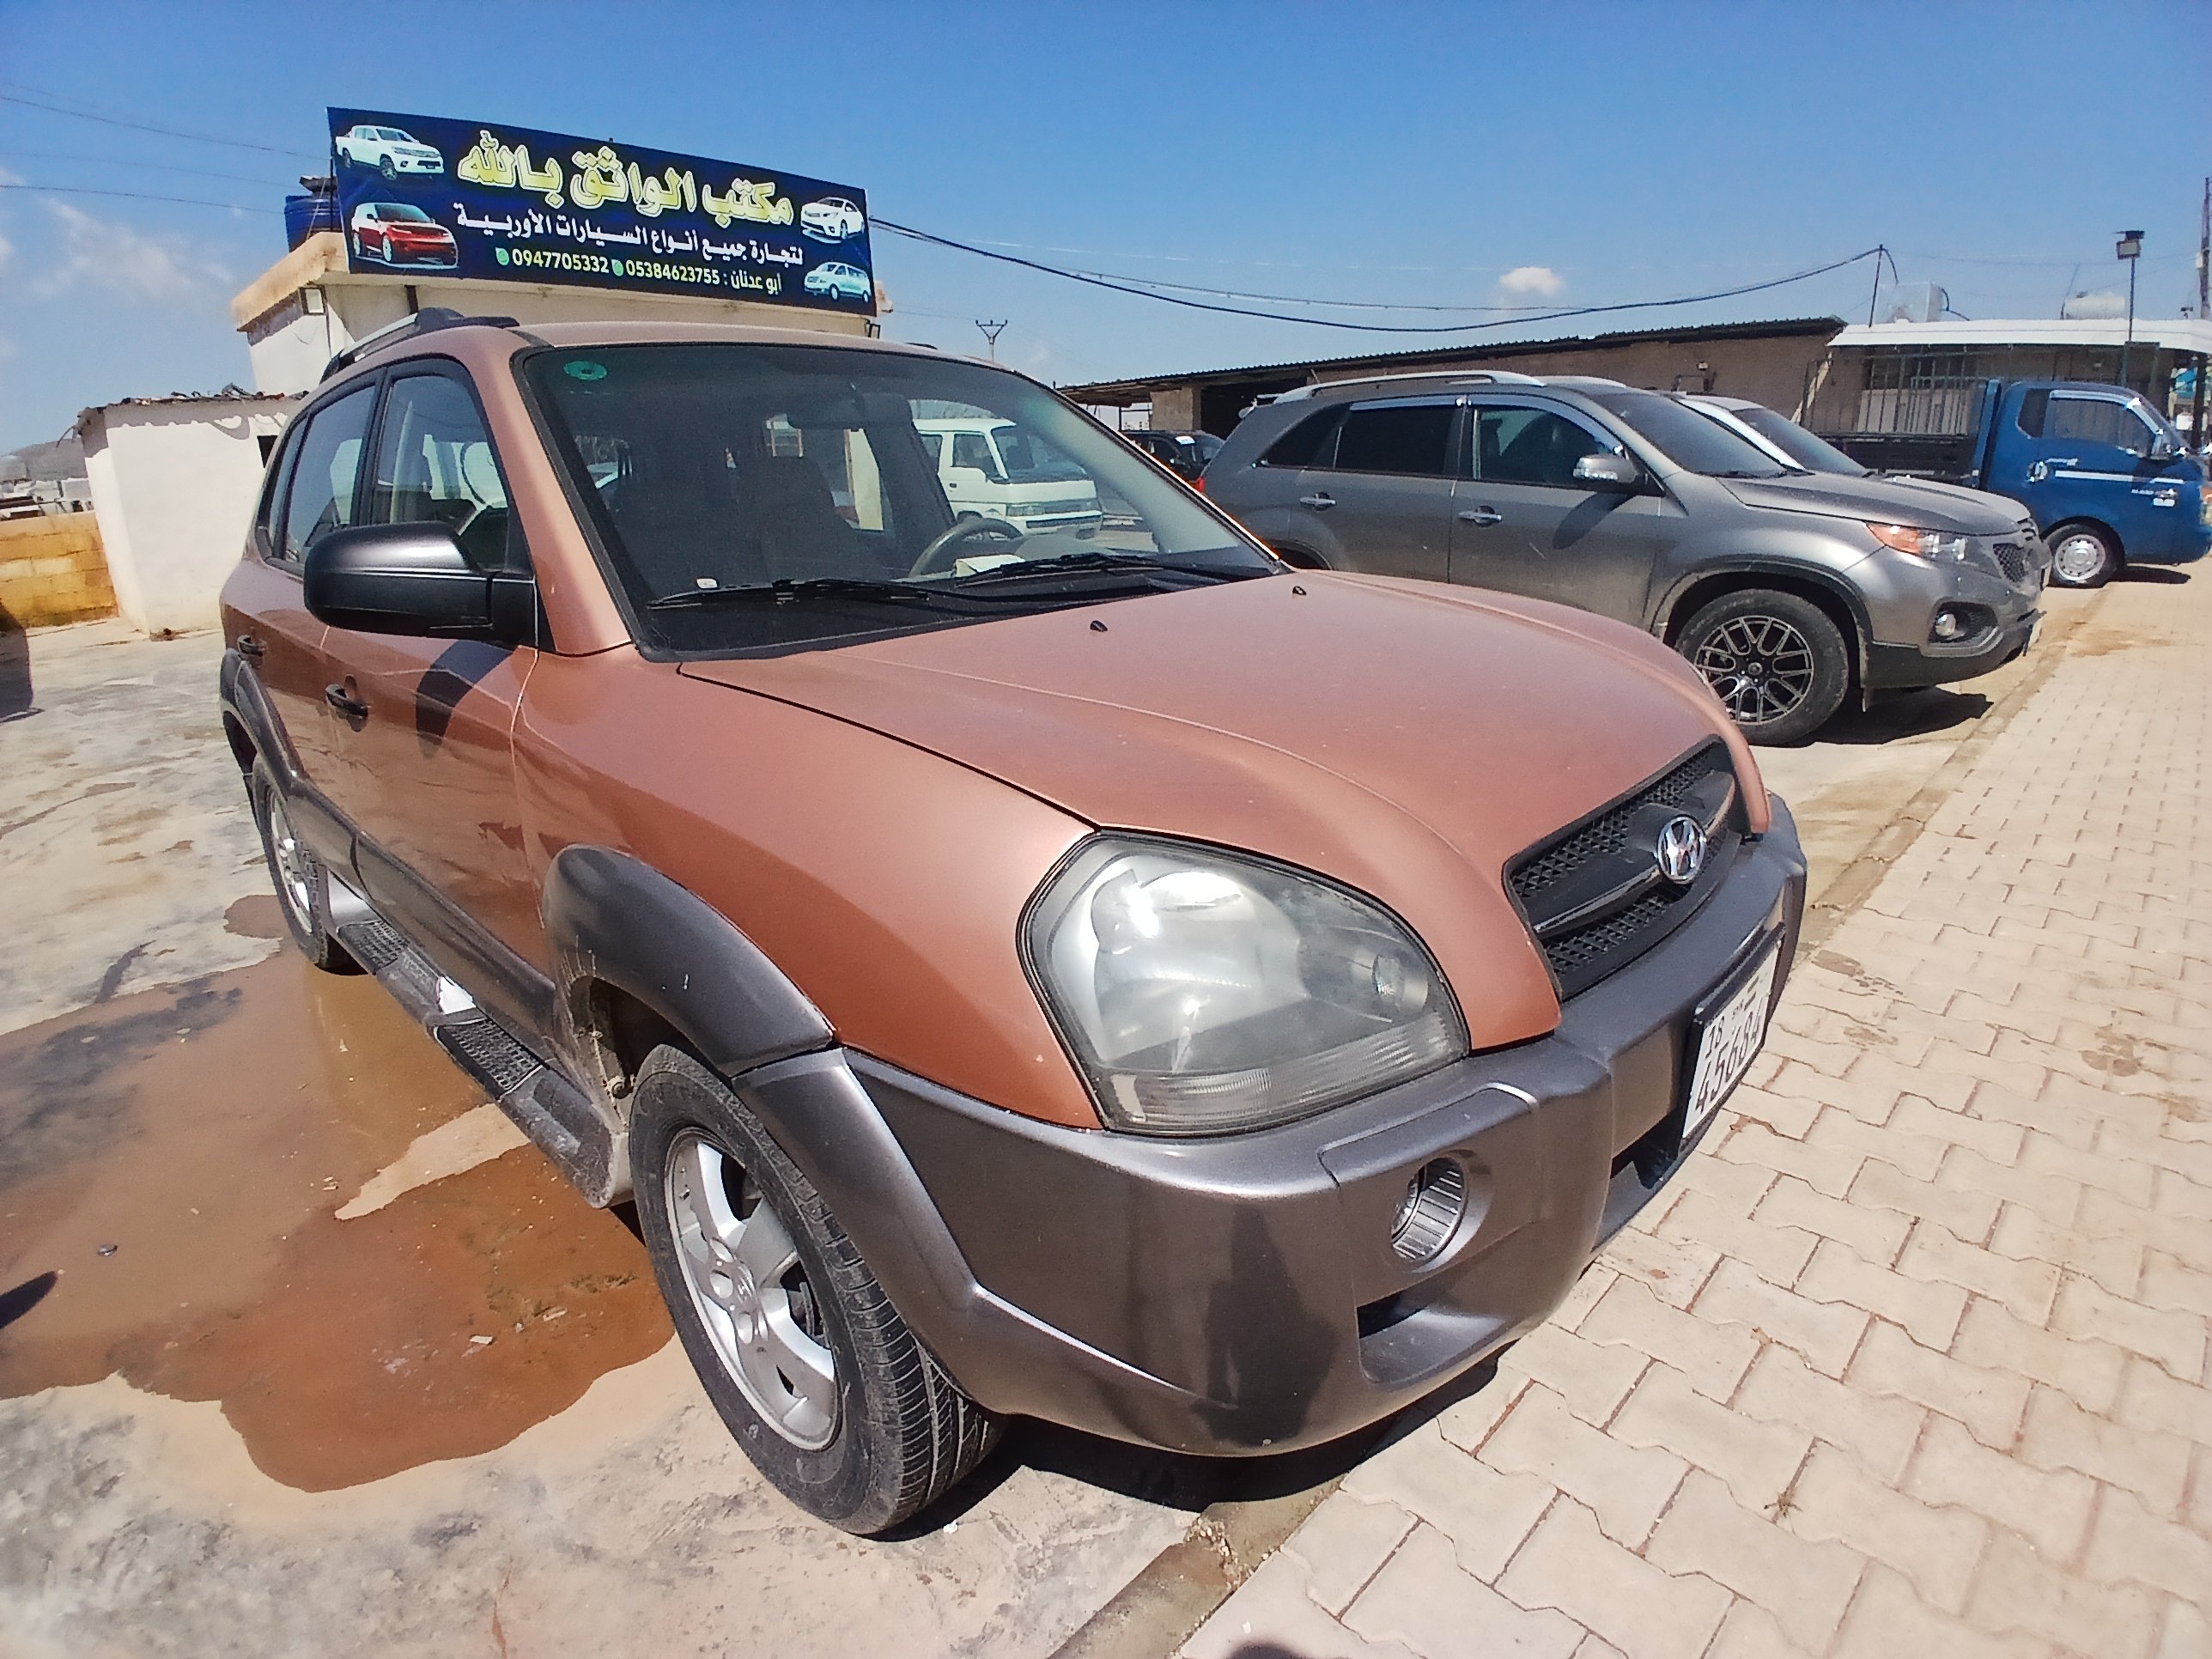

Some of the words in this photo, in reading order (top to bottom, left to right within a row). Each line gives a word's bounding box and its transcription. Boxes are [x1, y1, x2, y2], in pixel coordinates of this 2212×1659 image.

[457, 130, 564, 209] بالله
[570, 146, 696, 217] الواثق
[453, 202, 552, 239] الأوربية
[702, 178, 793, 228] مكتب
[556, 214, 648, 247] السيارات
[702, 237, 747, 261] جميع
[512, 248, 610, 274] 0947705332
[625, 259, 720, 285] 05384623755
[750, 240, 803, 268] لتجارة
[1695, 997, 1764, 1115] 45684
[1705, 1016, 1725, 1060] 18
